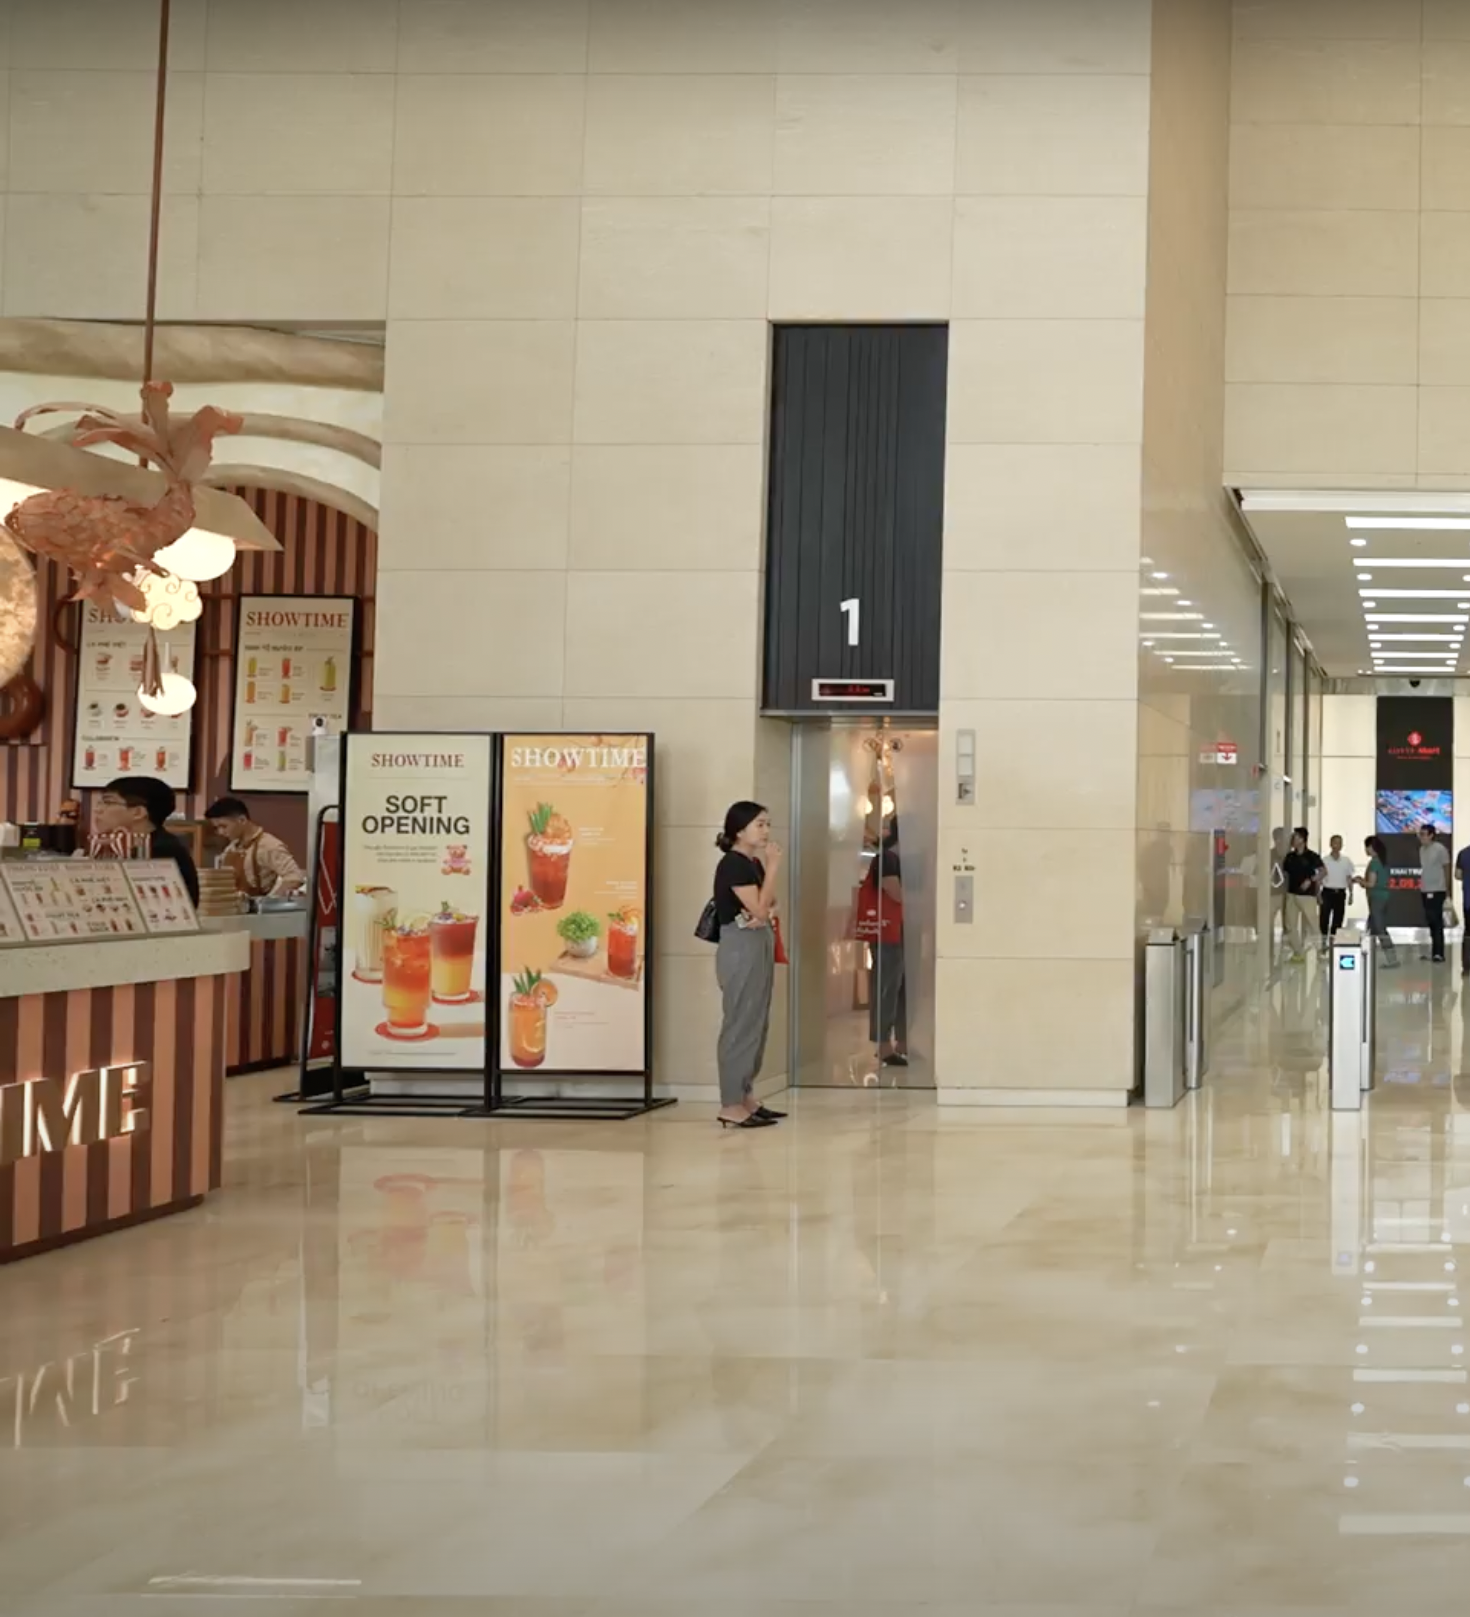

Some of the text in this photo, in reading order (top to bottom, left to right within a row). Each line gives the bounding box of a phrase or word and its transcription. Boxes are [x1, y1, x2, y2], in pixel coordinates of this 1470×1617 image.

[246, 611, 349, 628] SHOWTIME
[839, 597, 861, 646] 1
[371, 753, 465, 768] SHOWTIME
[511, 747, 647, 768] SHOWTIME
[385, 794, 447, 814] SOFT
[361, 815, 470, 835] OPENING
